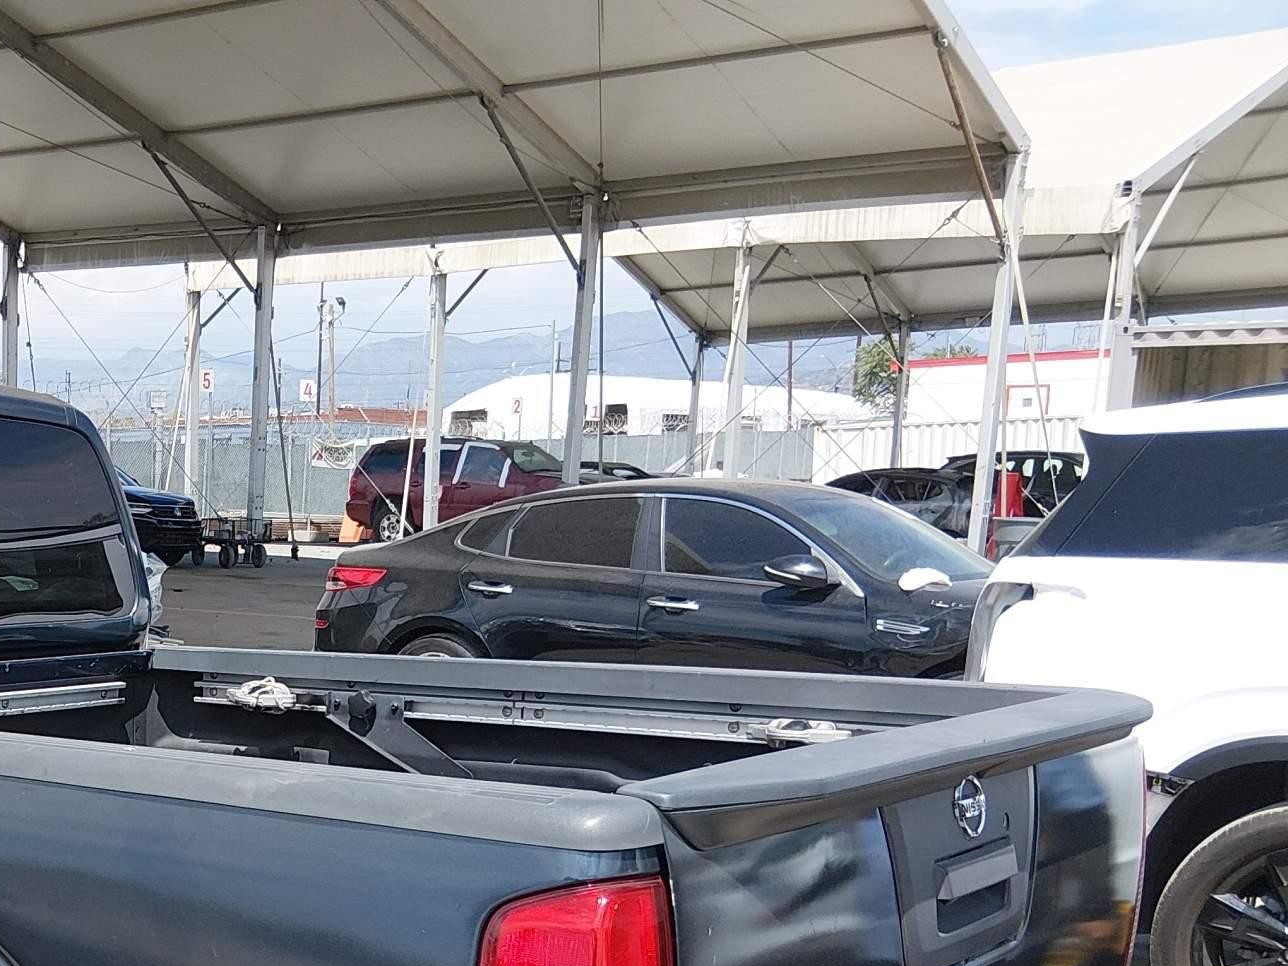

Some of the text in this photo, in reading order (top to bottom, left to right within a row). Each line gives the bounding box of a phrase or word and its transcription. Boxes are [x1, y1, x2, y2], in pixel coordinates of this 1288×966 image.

[202, 372, 211, 390] 5
[303, 382, 313, 399] 4
[513, 399, 522, 414] 2
[591, 405, 600, 419] 1
